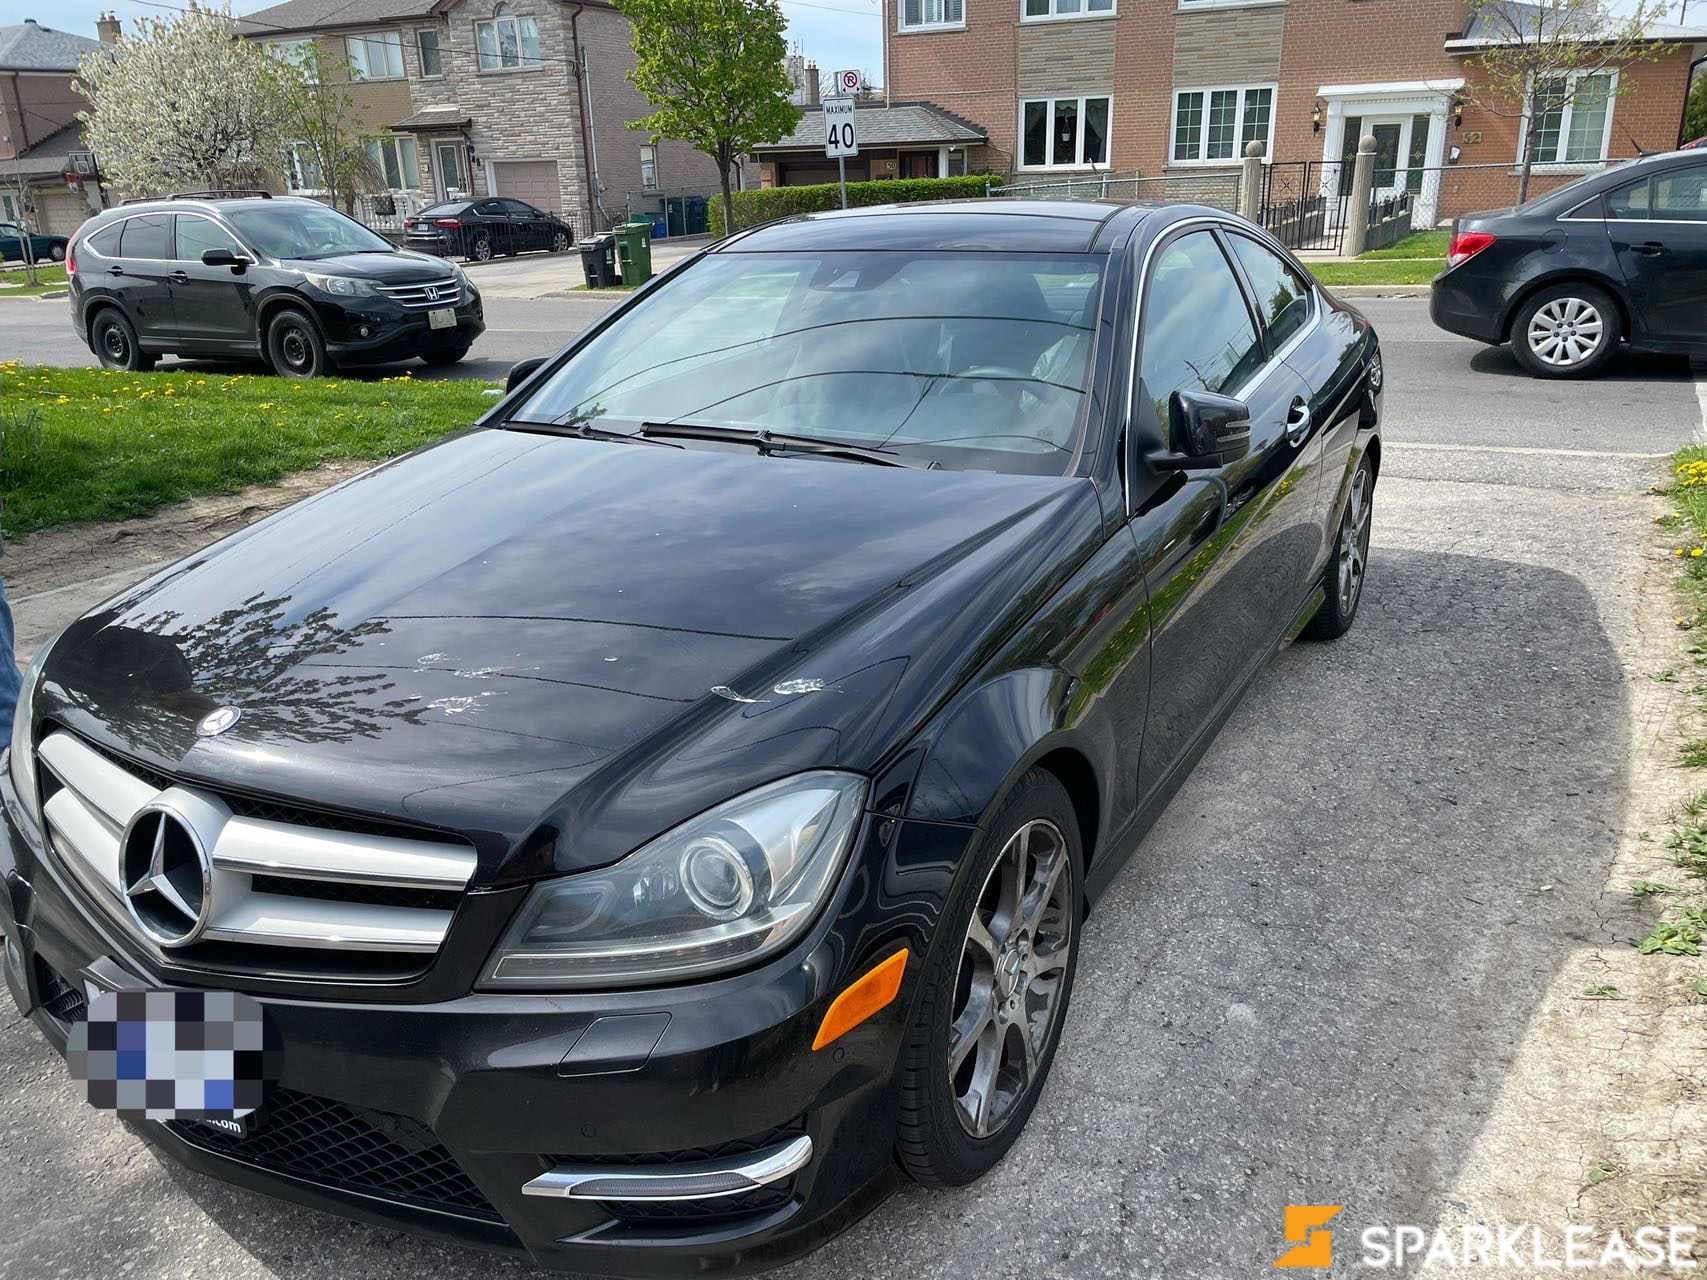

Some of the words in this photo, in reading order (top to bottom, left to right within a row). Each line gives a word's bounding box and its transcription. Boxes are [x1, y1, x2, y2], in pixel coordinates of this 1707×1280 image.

[826, 105, 853, 113] MAXIMUM
[828, 123, 854, 149] 40
[1464, 132, 1480, 144] 52
[206, 1119, 241, 1133] .com
